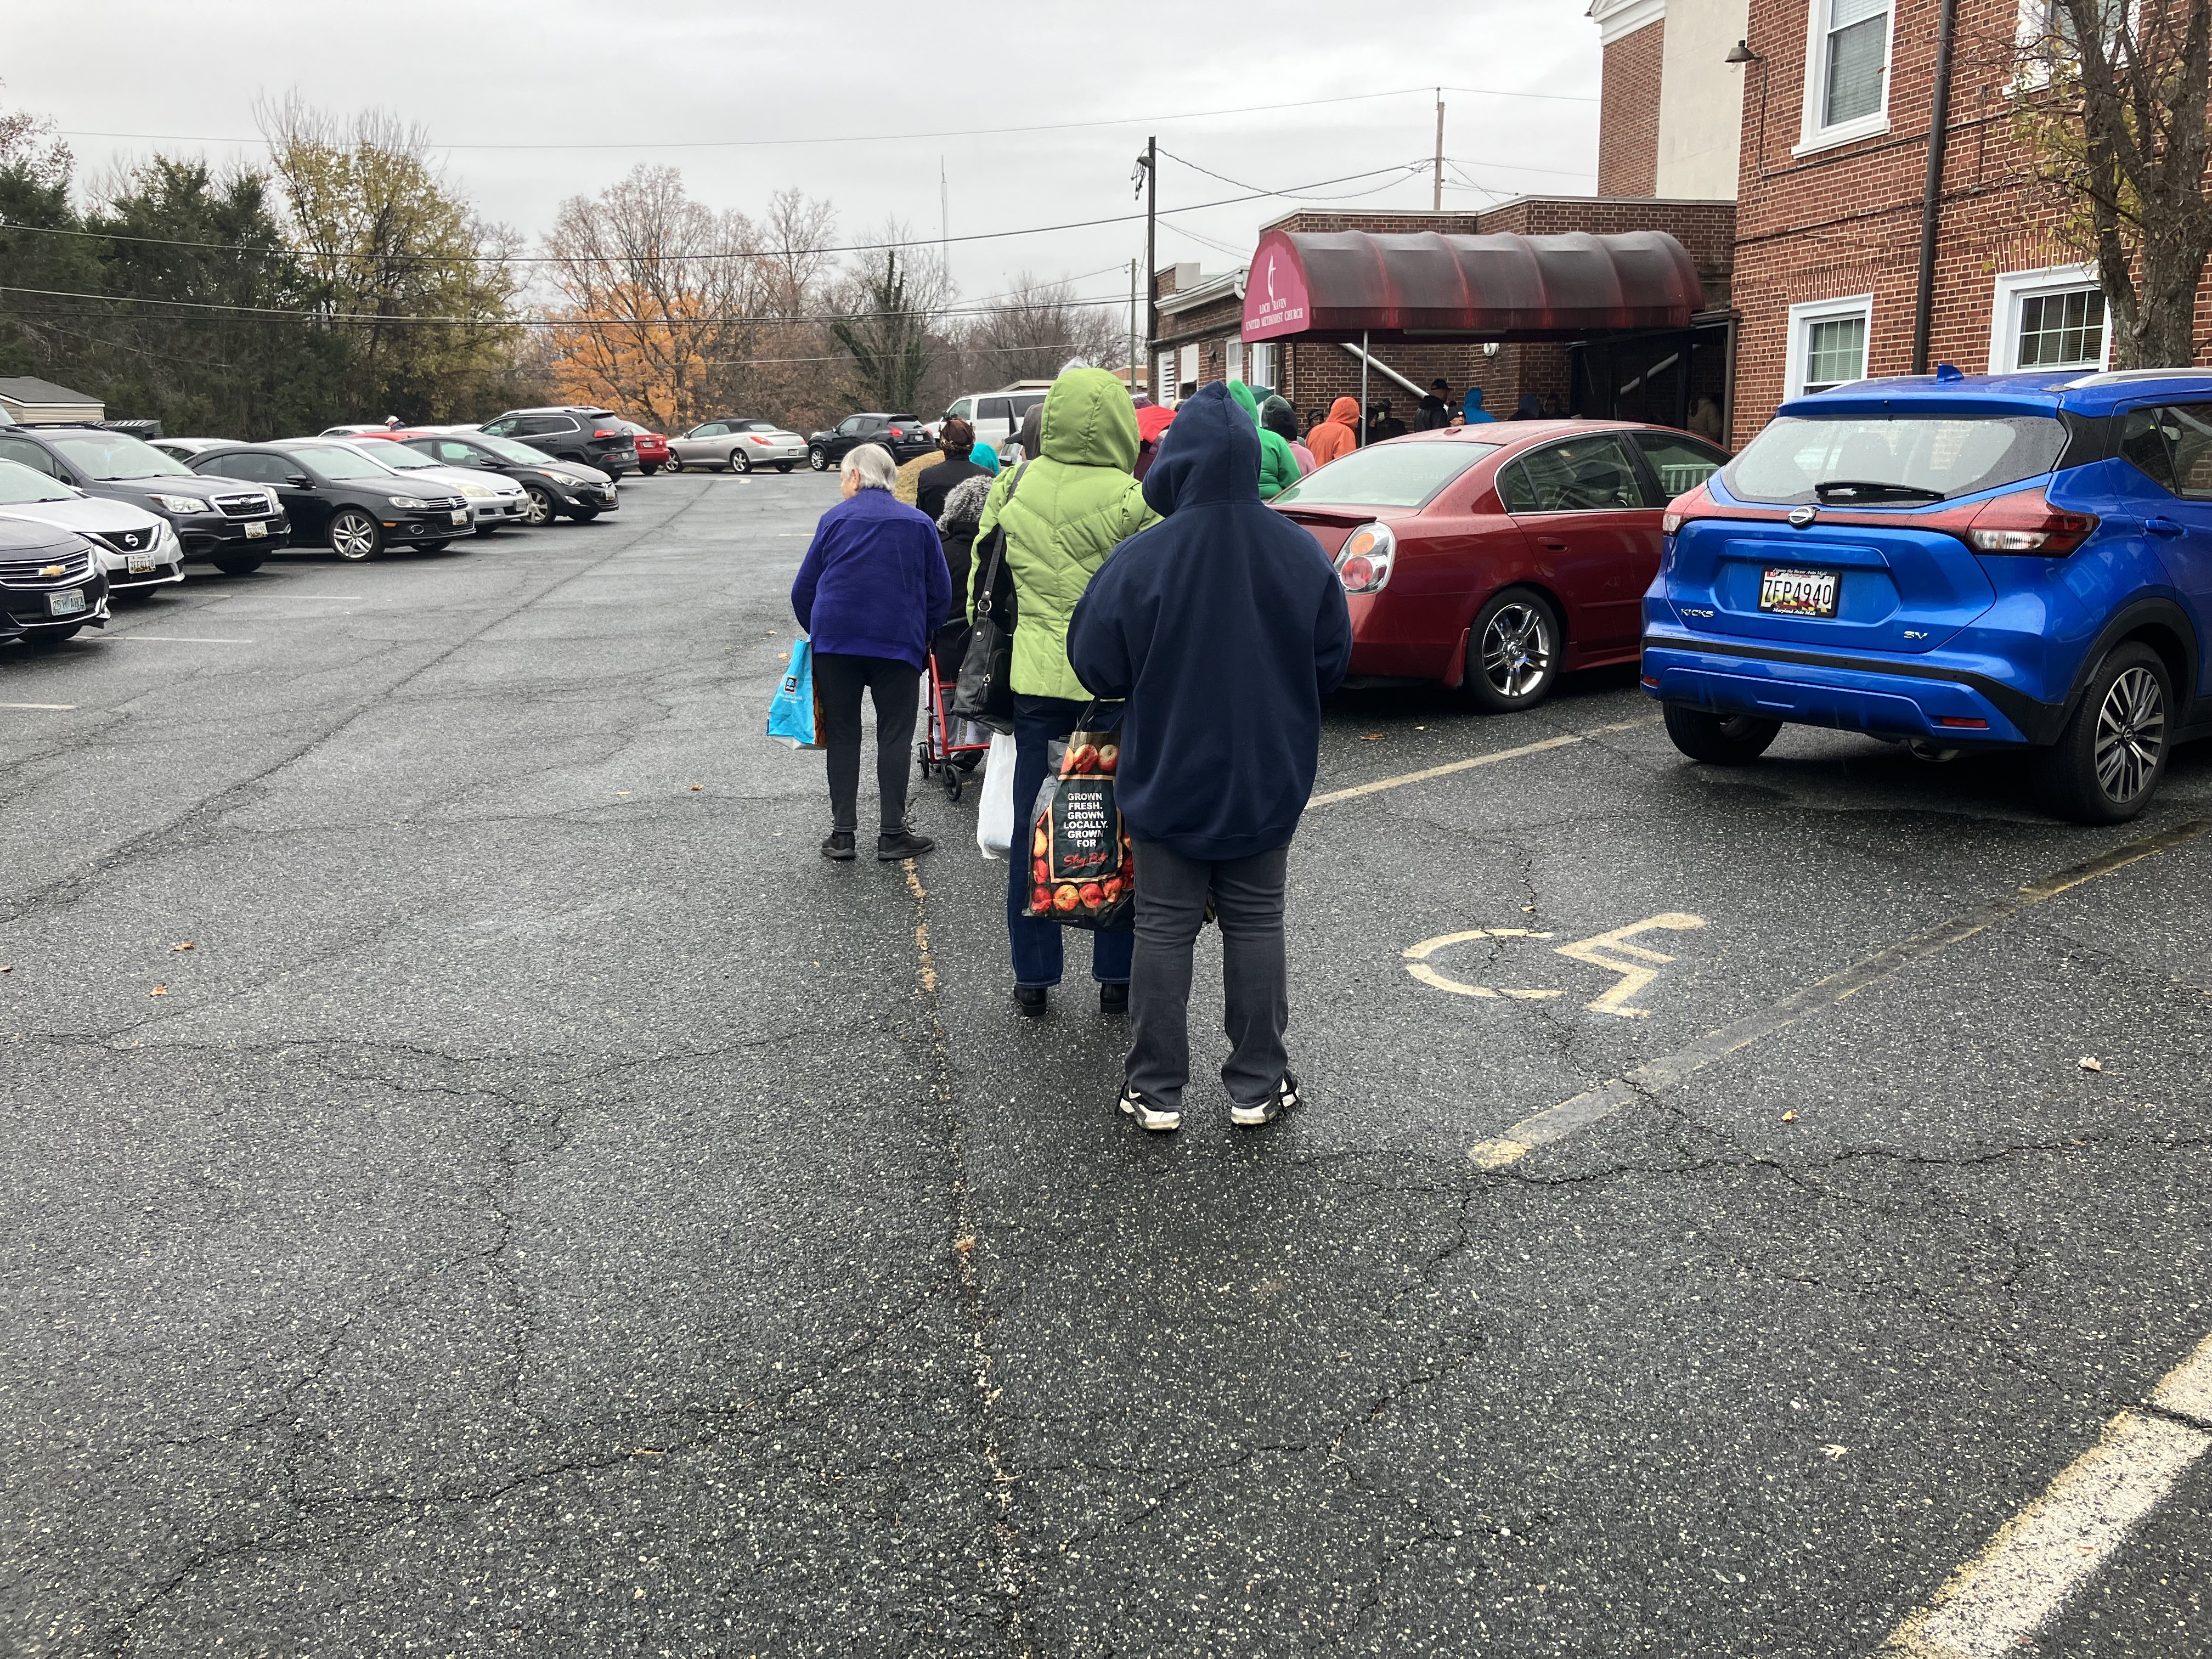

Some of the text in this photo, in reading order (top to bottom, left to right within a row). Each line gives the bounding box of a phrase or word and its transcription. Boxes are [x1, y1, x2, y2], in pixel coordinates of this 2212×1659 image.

[1259, 298, 1286, 314] LOCH RAVEN
[1246, 308, 1303, 331] UNITED METHODIST CHURCH
[1680, 608, 1714, 618] KICKS
[1903, 630, 1928, 640] SV
[1068, 802, 1103, 810] FRESH.
[1067, 811, 1104, 820] GROWN
[1063, 820, 1108, 829] LOCALLY.
[1067, 830, 1104, 838] GROWN
[1076, 839, 1097, 848] FOR
